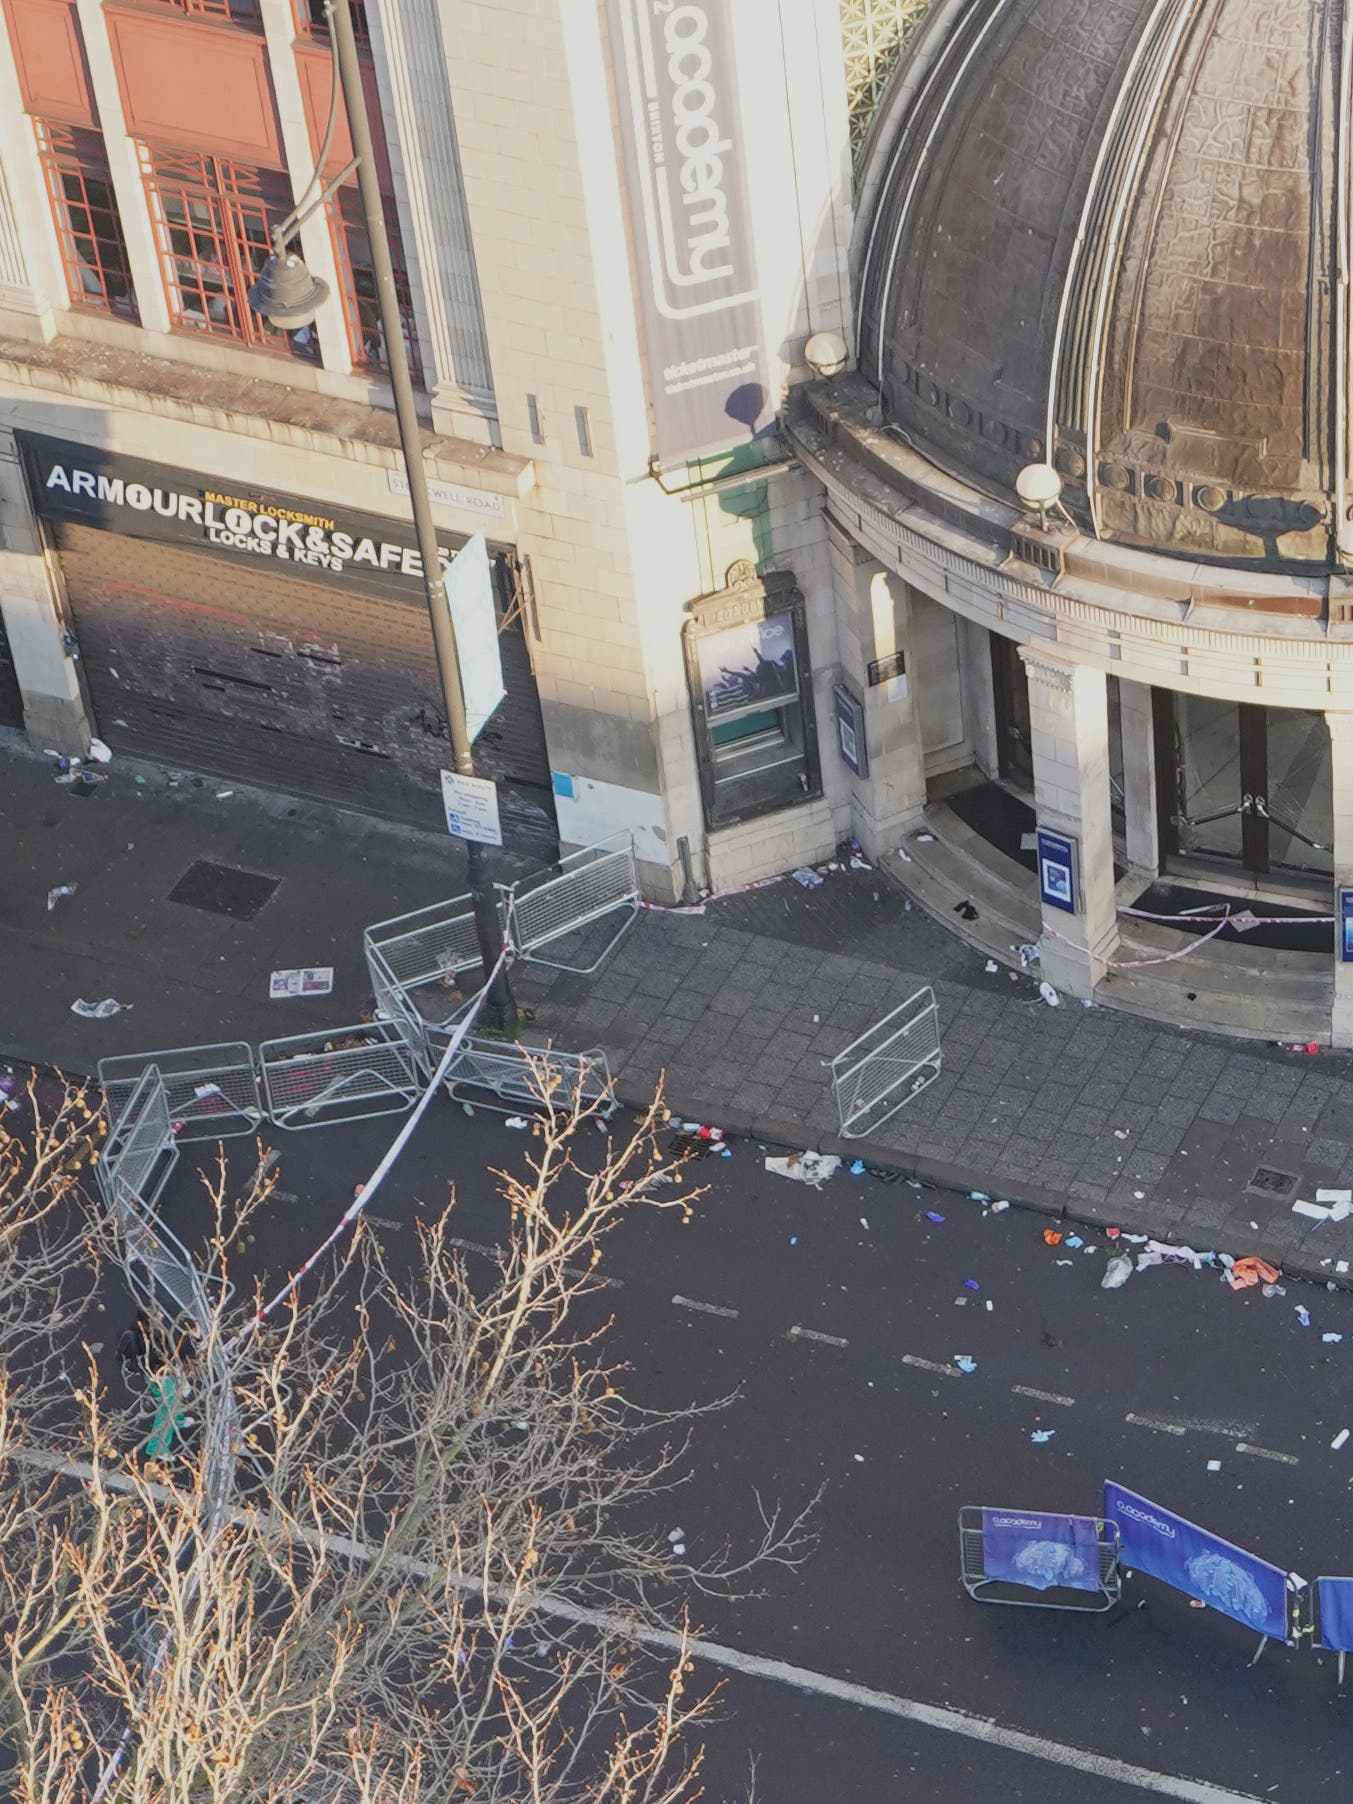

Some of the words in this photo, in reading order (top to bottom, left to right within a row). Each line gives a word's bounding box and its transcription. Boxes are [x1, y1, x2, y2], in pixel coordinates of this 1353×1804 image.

[205, 491, 257, 513] MASTER
[259, 505, 335, 530] LOCKSMITH
[209, 528, 272, 555] LOCKS
[294, 548, 343, 572] KEYS
